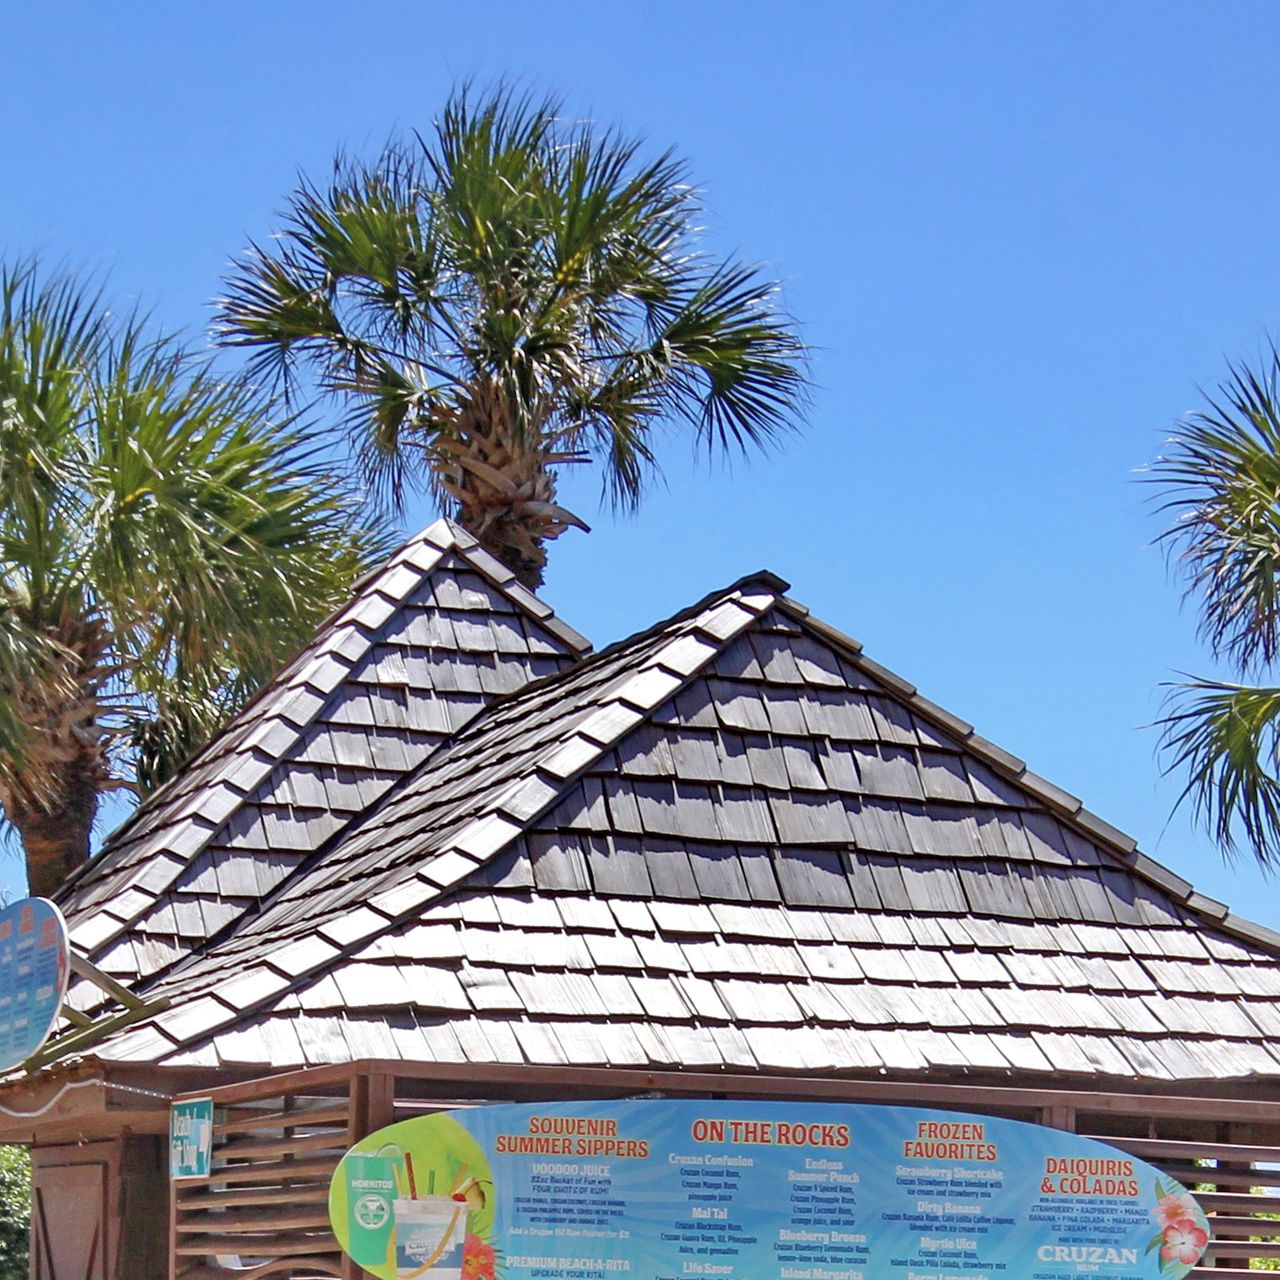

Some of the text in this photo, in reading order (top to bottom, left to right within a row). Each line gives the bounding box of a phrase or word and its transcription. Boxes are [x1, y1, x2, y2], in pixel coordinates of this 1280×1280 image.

[529, 1116, 617, 1137] SOUVENIR
[691, 1119, 851, 1147] ON THE ROCKS
[917, 1121, 984, 1141] FROZEN
[495, 1135, 649, 1158] SUMMER SIPPERS
[904, 1141, 997, 1161] FAVORITES
[668, 1152, 754, 1167] Cruzan Confusion
[804, 1158, 844, 1170] Endless
[532, 1163, 610, 1177] VOODOO JUICE
[895, 1164, 1004, 1180] Strawberry Shortcake
[1045, 1157, 1134, 1178] DAIQUIRIS
[788, 1169, 860, 1183] Summer Punch
[351, 1179, 394, 1189] HORNITOS
[532, 1186, 551, 1194] FOUR
[579, 1186, 589, 1195] OF
[1040, 1176, 1139, 1197] & COLADAS
[691, 1207, 728, 1219] Mai Tai
[917, 1201, 981, 1216] Dirty Banana
[1031, 1205, 1149, 1216] STRAWBERRY RASPBERRY MANGO
[779, 1228, 867, 1245] Blueberry Breeze
[920, 1236, 977, 1251] Myrtle Vice
[1036, 1245, 1138, 1265] CRUZAN
[506, 1255, 630, 1271] PREMIUM BEACH-A-RITA
[682, 1262, 734, 1274] Life Saver
[1075, 1264, 1100, 1272] RUM
[531, 1269, 564, 1278] UPGRADE
[566, 1270, 585, 1278] YOUR
[780, 1267, 811, 1279] Island
